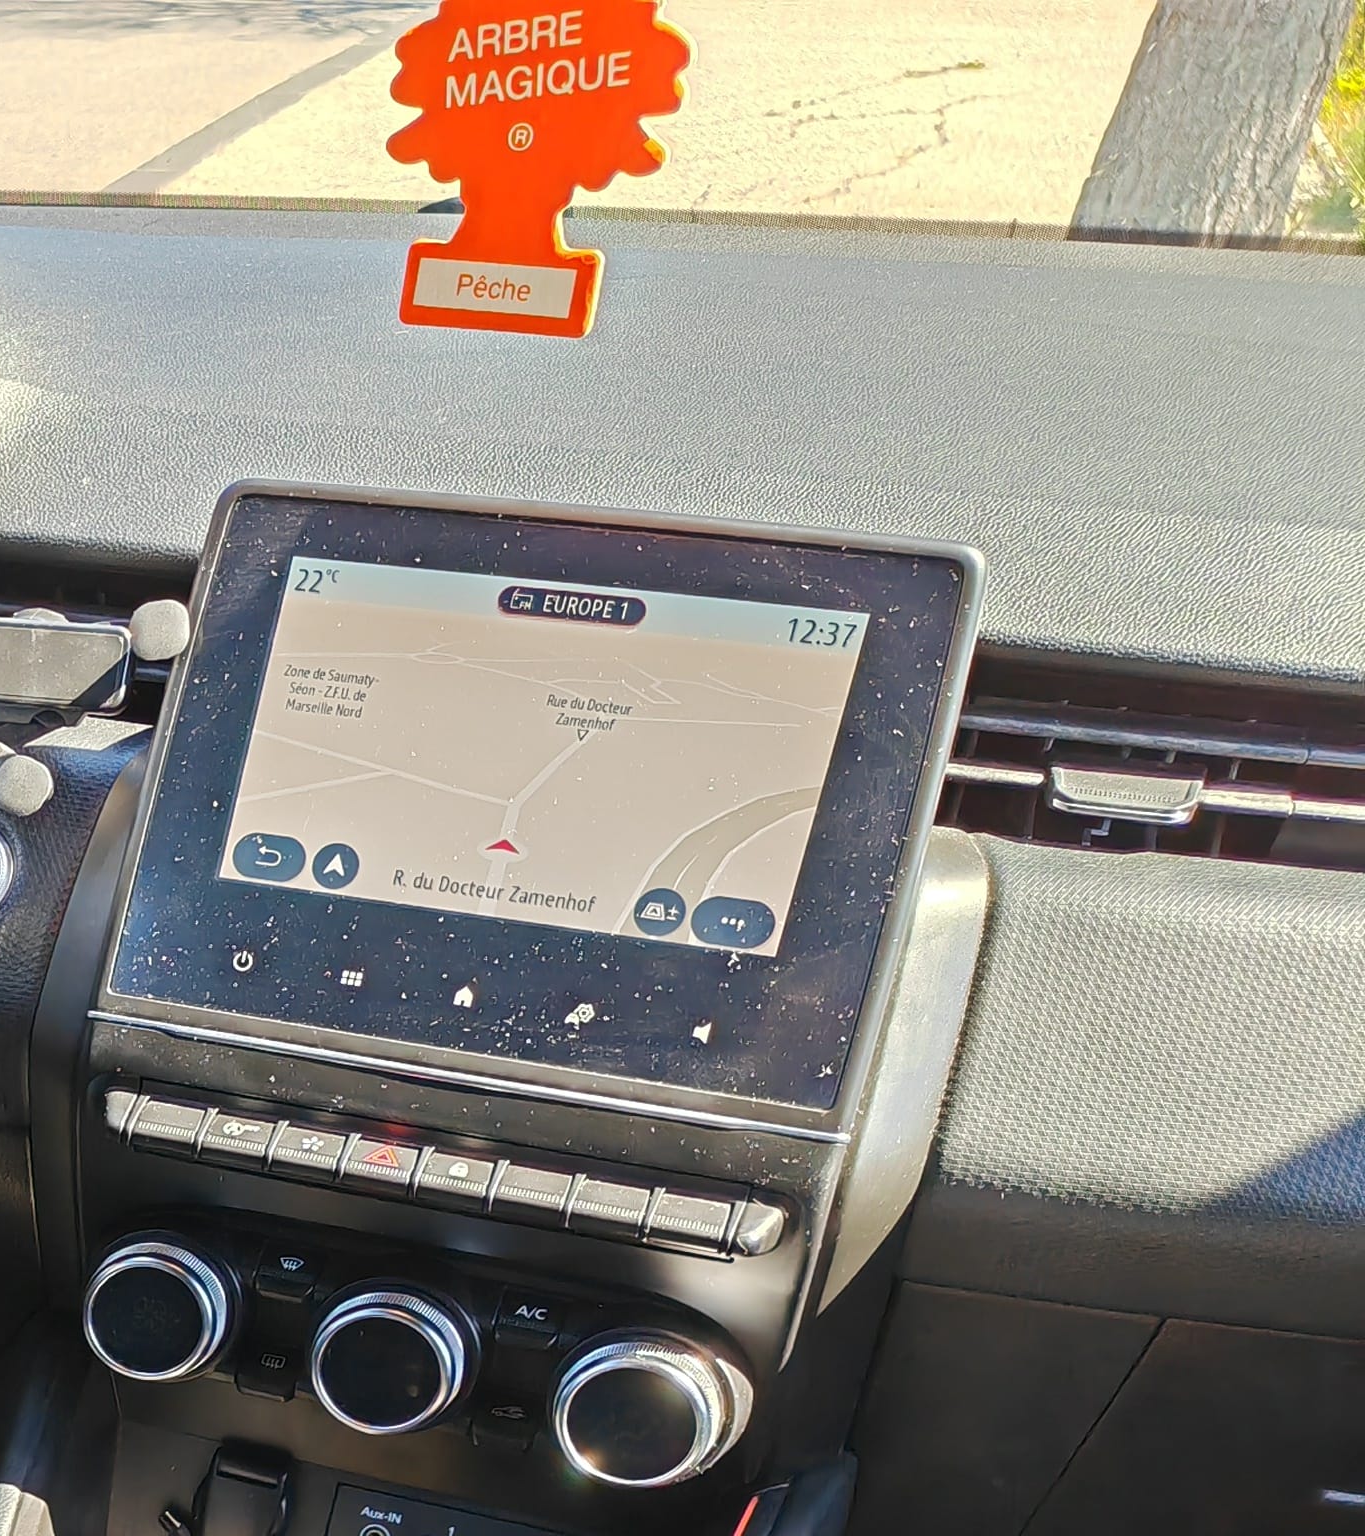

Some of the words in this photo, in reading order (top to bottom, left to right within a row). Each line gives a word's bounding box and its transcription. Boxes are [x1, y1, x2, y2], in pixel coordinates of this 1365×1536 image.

[447, 10, 583, 62] ARBRE
[445, 51, 631, 108] MAGIQUE
[455, 273, 531, 302] Pêche
[543, 596, 615, 620] EUROPE
[619, 601, 629, 620] 1
[787, 618, 858, 648] 12:37
[284, 665, 311, 680] Zone
[313, 667, 326, 681] de
[328, 669, 380, 687] Saumaty-
[289, 682, 316, 697] Séon
[353, 689, 367, 703] de
[285, 699, 333, 718] Marseille
[335, 704, 362, 719] Nord
[546, 694, 567, 709] Rue
[568, 695, 585, 710] du
[588, 698, 632, 716] Docteur
[555, 713, 617, 732] Zamenhof
[392, 869, 408, 887] R.
[413, 872, 433, 891] du
[439, 876, 505, 901] Docteur
[509, 886, 597, 914] Zamenhof
[514, 1305, 548, 1320] A/C
[448, 1526, 456, 1536] 1
